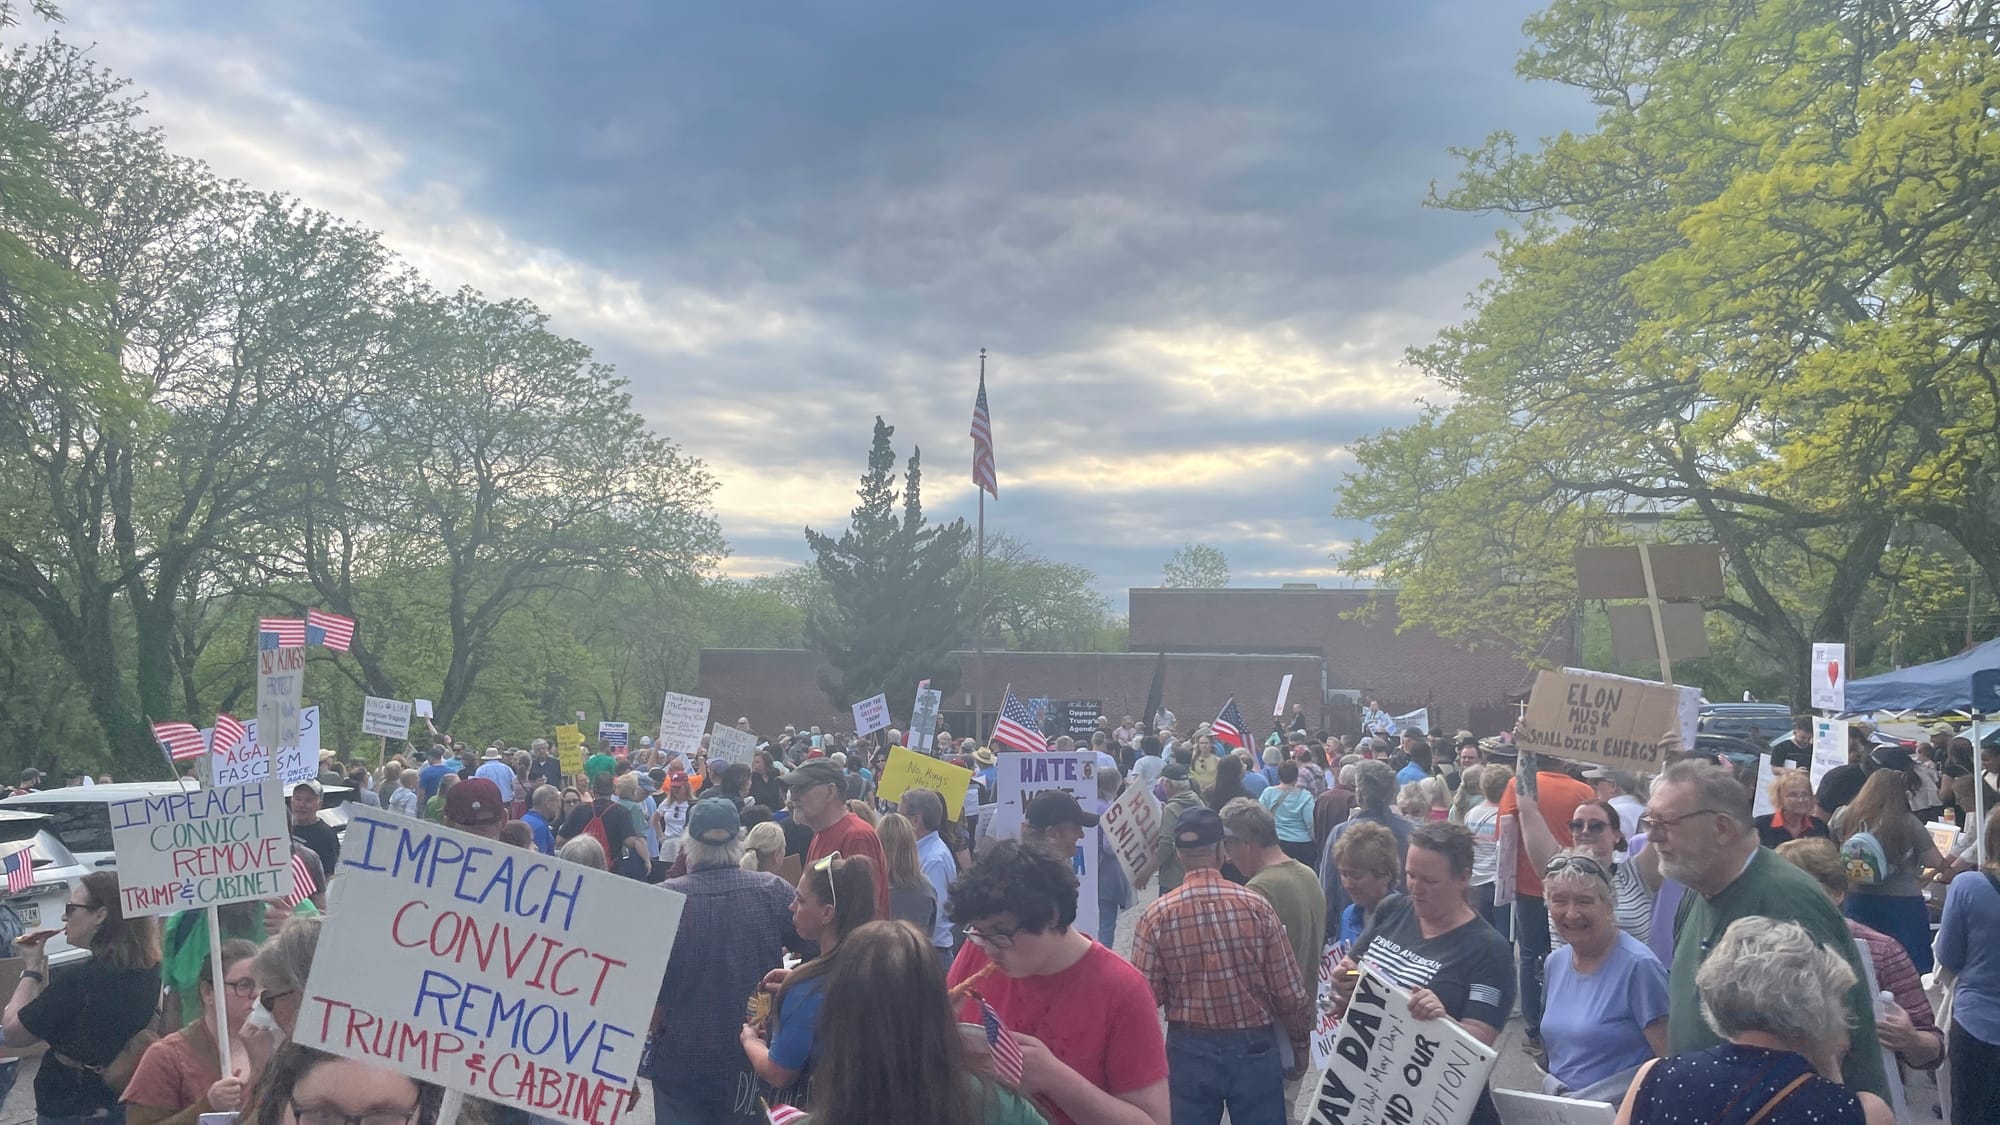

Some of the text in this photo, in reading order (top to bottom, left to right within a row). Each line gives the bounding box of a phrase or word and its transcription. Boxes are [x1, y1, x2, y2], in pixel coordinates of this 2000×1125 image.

[261, 647, 304, 671] NO KINGS
[1069, 709, 1097, 717] Oppose
[1566, 682, 1623, 713] ELON
[1568, 706, 1612, 729] MUSK
[1572, 723, 1597, 736] HAS
[712, 735, 746, 754] CONVICT
[1527, 728, 1658, 762] SMALL DICK ENERGY
[219, 752, 302, 784] FASCISM
[907, 760, 921, 775] No
[1020, 758, 1078, 783] HATE
[112, 783, 265, 829] IMPEACH
[150, 812, 265, 852] CONVICT
[1106, 803, 1148, 874] UTIN'S
[172, 837, 287, 878] REMOVE
[342, 816, 584, 932] IMPEACH
[122, 869, 283, 911] TRUMP & CABINET
[391, 899, 628, 1007] CONVICT
[1373, 935, 1442, 970] PROUD AMERICAN
[413, 969, 635, 1084] REMOVE
[1378, 1013, 1405, 1052] Day!
[311, 995, 633, 1125] TRUMP & CABINET
[1309, 1067, 1356, 1125] AY
[1336, 972, 1391, 1073] DAY!
[1403, 1033, 1441, 1088] OUR
[1370, 1055, 1395, 1084] May
[1422, 1039, 1487, 1125] UTION!
